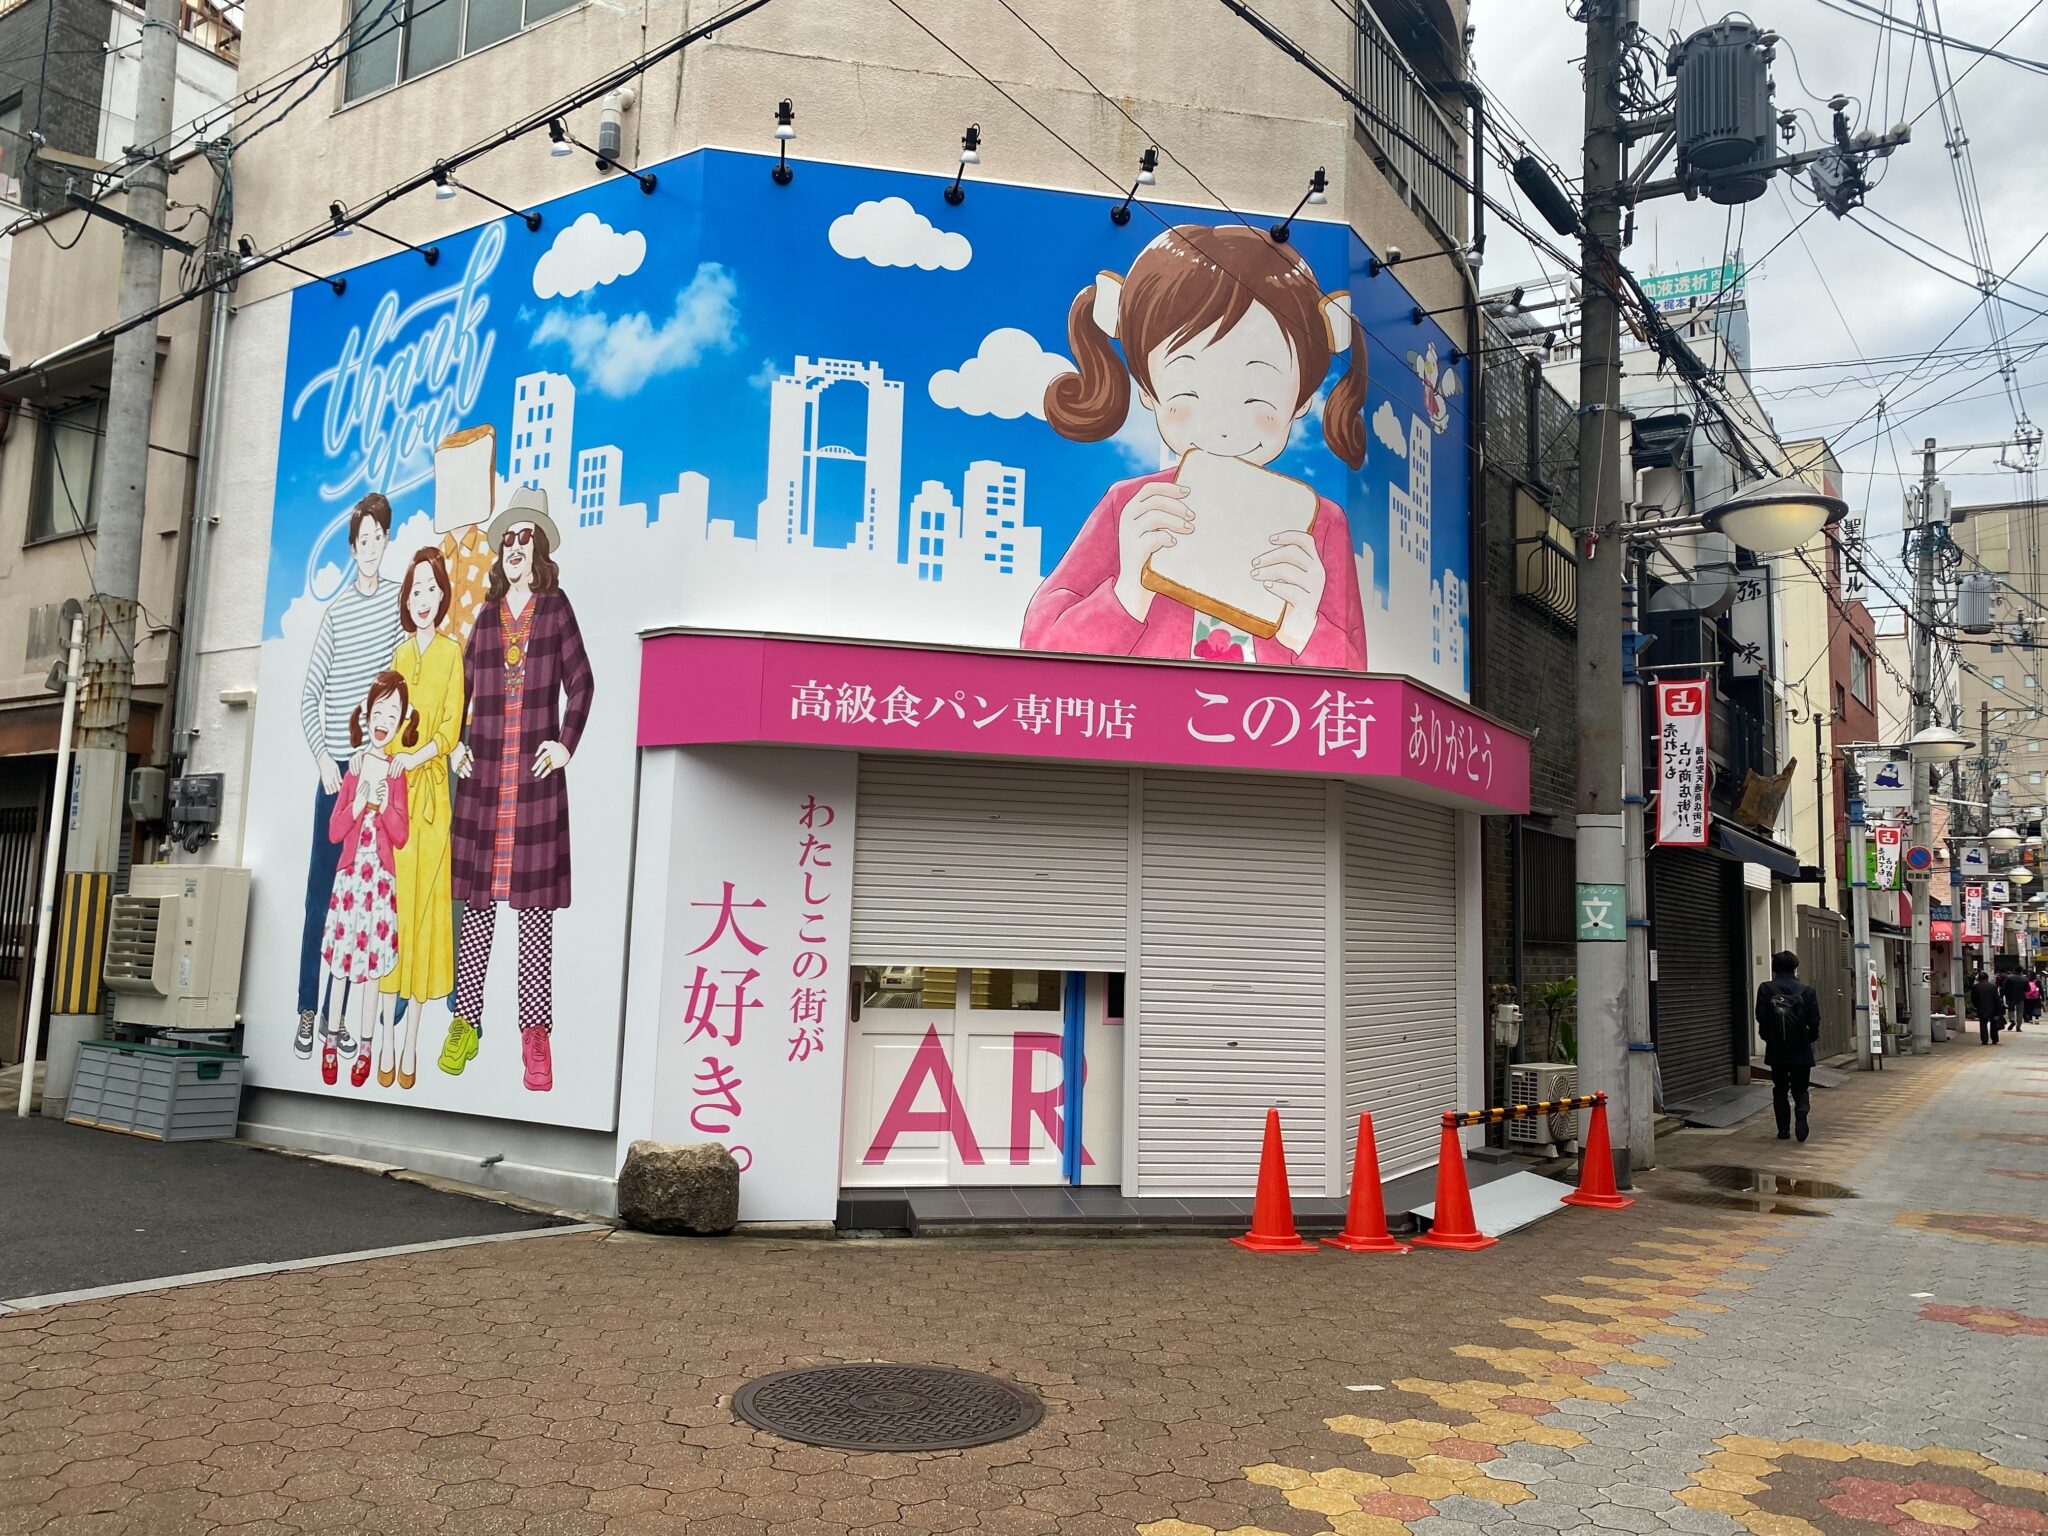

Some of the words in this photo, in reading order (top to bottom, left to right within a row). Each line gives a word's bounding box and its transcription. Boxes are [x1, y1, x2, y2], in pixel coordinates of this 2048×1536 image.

[1642, 273, 1708, 297] 血液透析
[1664, 289, 1743, 310] 梶本リニック
[292, 219, 507, 459] thank
[790, 679, 1138, 740] 高級食パン専門店
[1187, 688, 1377, 759] この街
[1408, 702, 1493, 791] ありがとう
[788, 794, 835, 1062] わたしこの街が
[683, 881, 768, 1172] 大好き。
